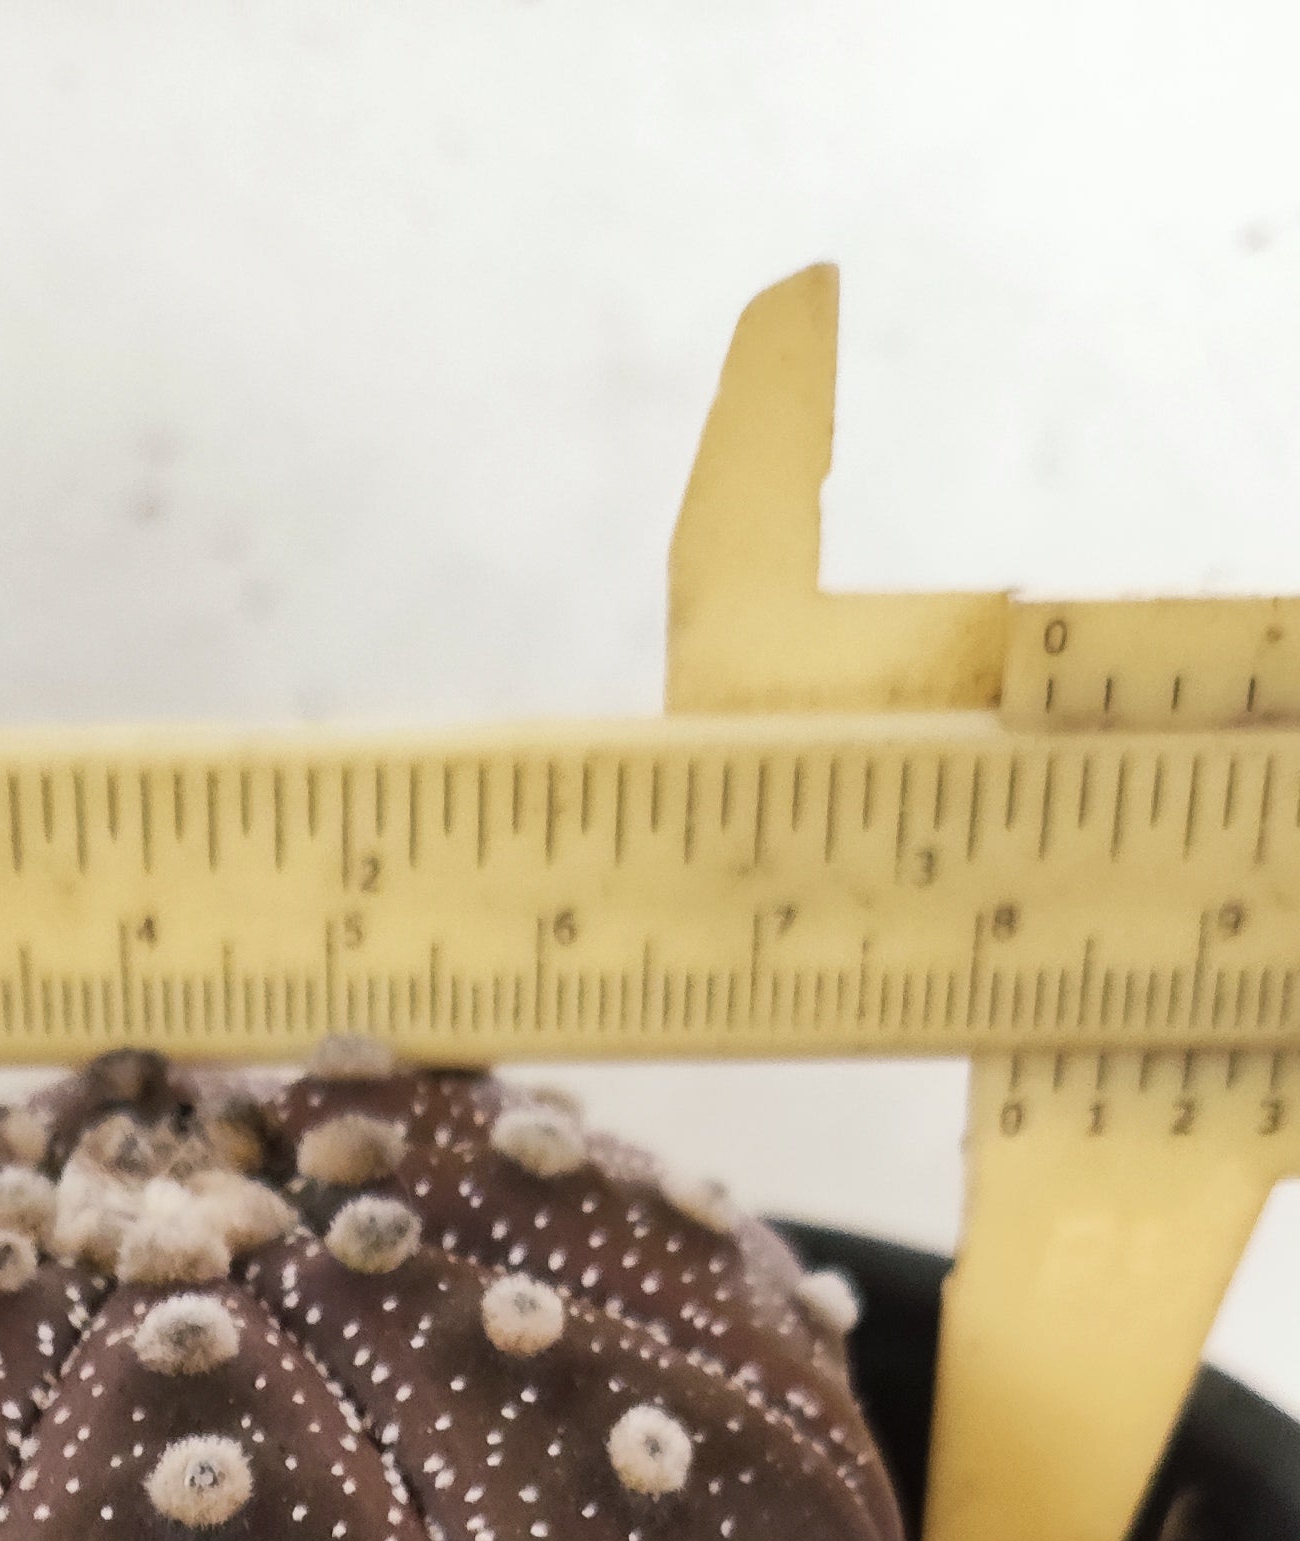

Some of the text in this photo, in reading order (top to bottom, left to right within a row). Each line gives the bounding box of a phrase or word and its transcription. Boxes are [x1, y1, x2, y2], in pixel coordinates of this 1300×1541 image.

[1043, 618, 1069, 656] 0
[358, 850, 384, 893] 2
[913, 843, 939, 889] 3
[136, 911, 159, 946] 4
[341, 911, 365, 949] 5
[553, 909, 579, 947] 6
[772, 902, 798, 939] 7
[991, 900, 1021, 943] 8
[1216, 900, 1247, 941] 9
[1000, 1098, 1287, 1138] 0 1 2 3
